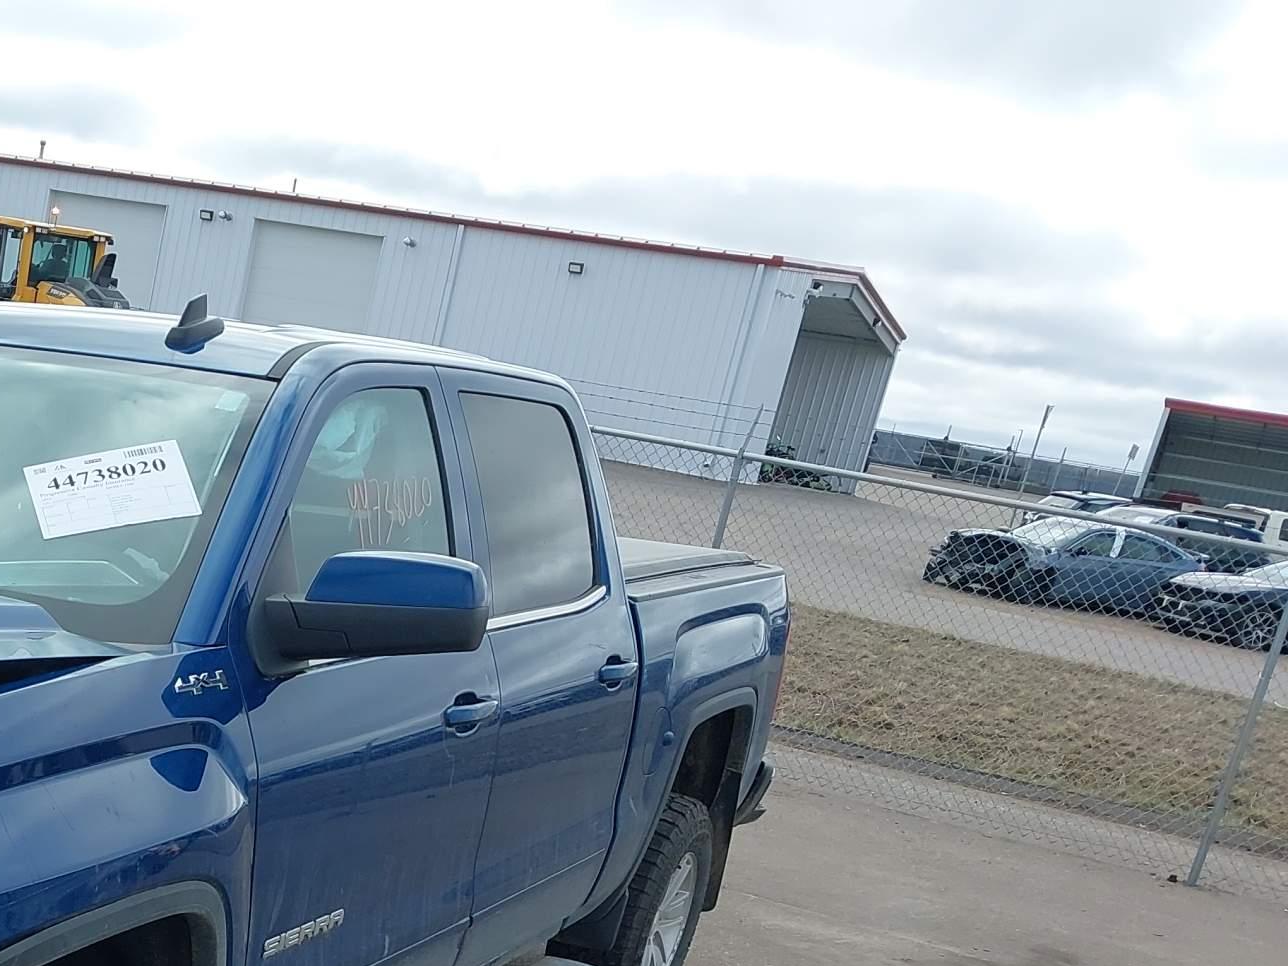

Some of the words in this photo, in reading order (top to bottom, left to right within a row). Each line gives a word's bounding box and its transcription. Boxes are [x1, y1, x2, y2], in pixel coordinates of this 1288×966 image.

[47, 458, 167, 490] 44738020
[347, 476, 432, 551] 44738020
[263, 908, 344, 960] SIERRA
